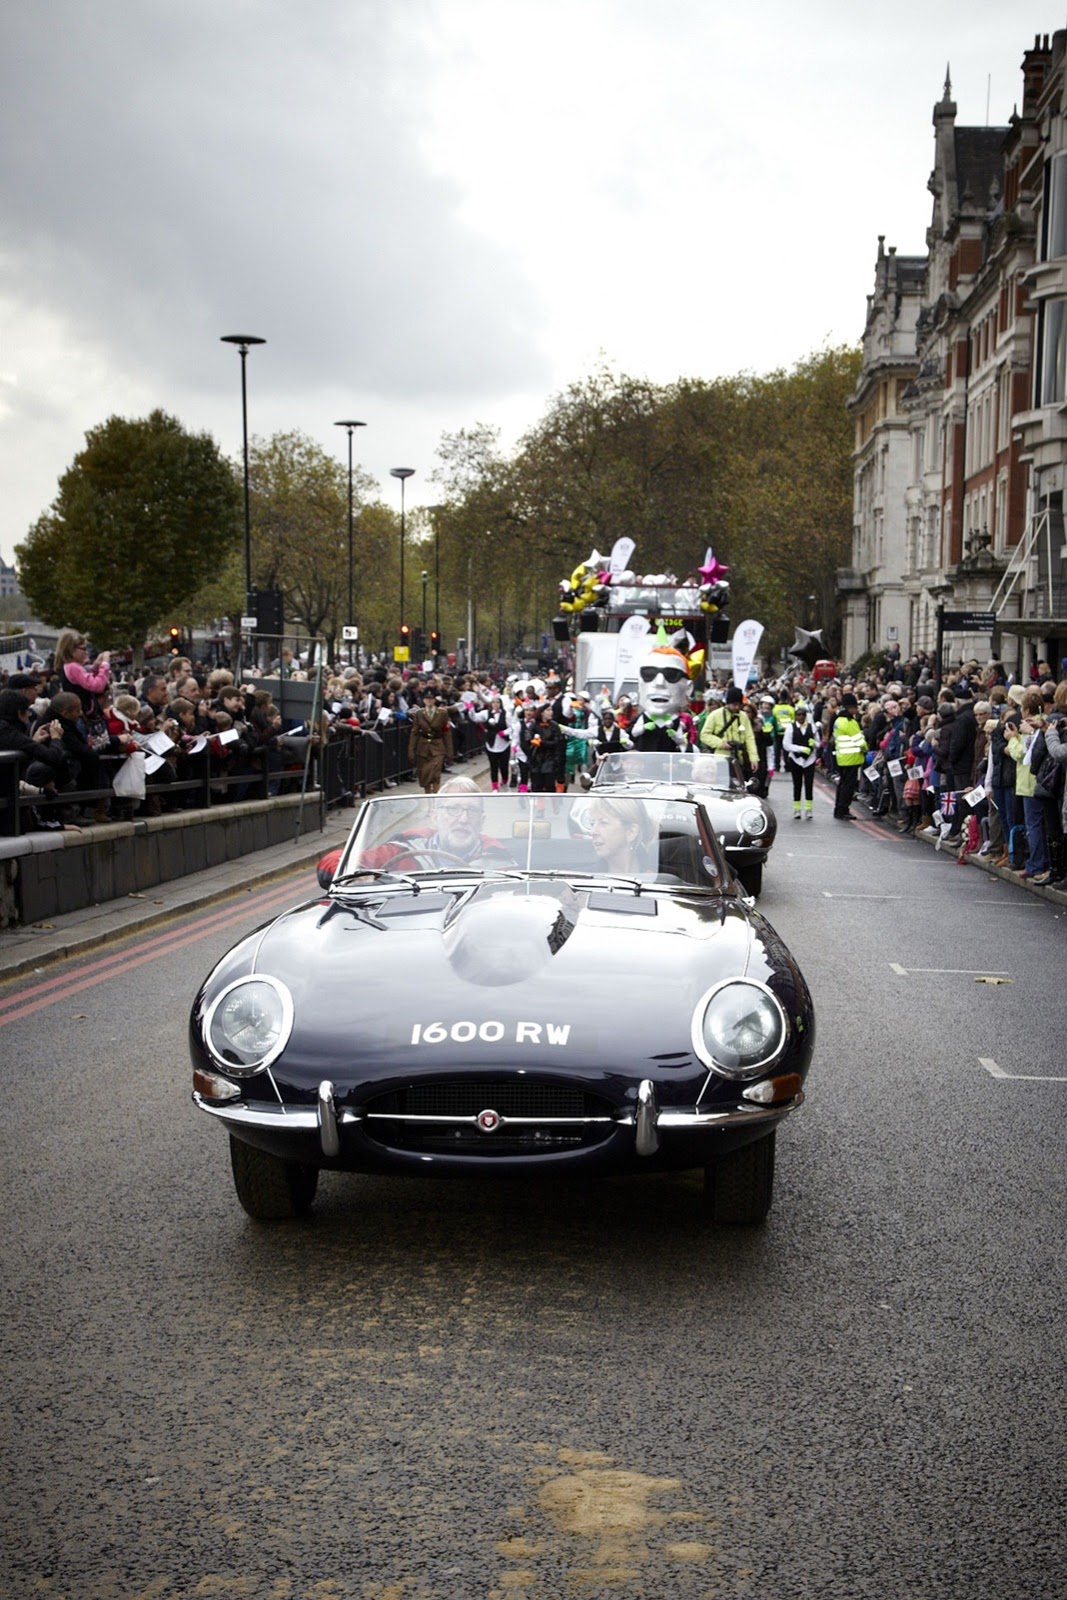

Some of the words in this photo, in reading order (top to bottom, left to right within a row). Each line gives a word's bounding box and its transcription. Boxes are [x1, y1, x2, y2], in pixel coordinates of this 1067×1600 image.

[654, 617, 684, 627] BIDGE
[410, 1021, 505, 1045] 1600
[515, 1021, 571, 1046] RW
